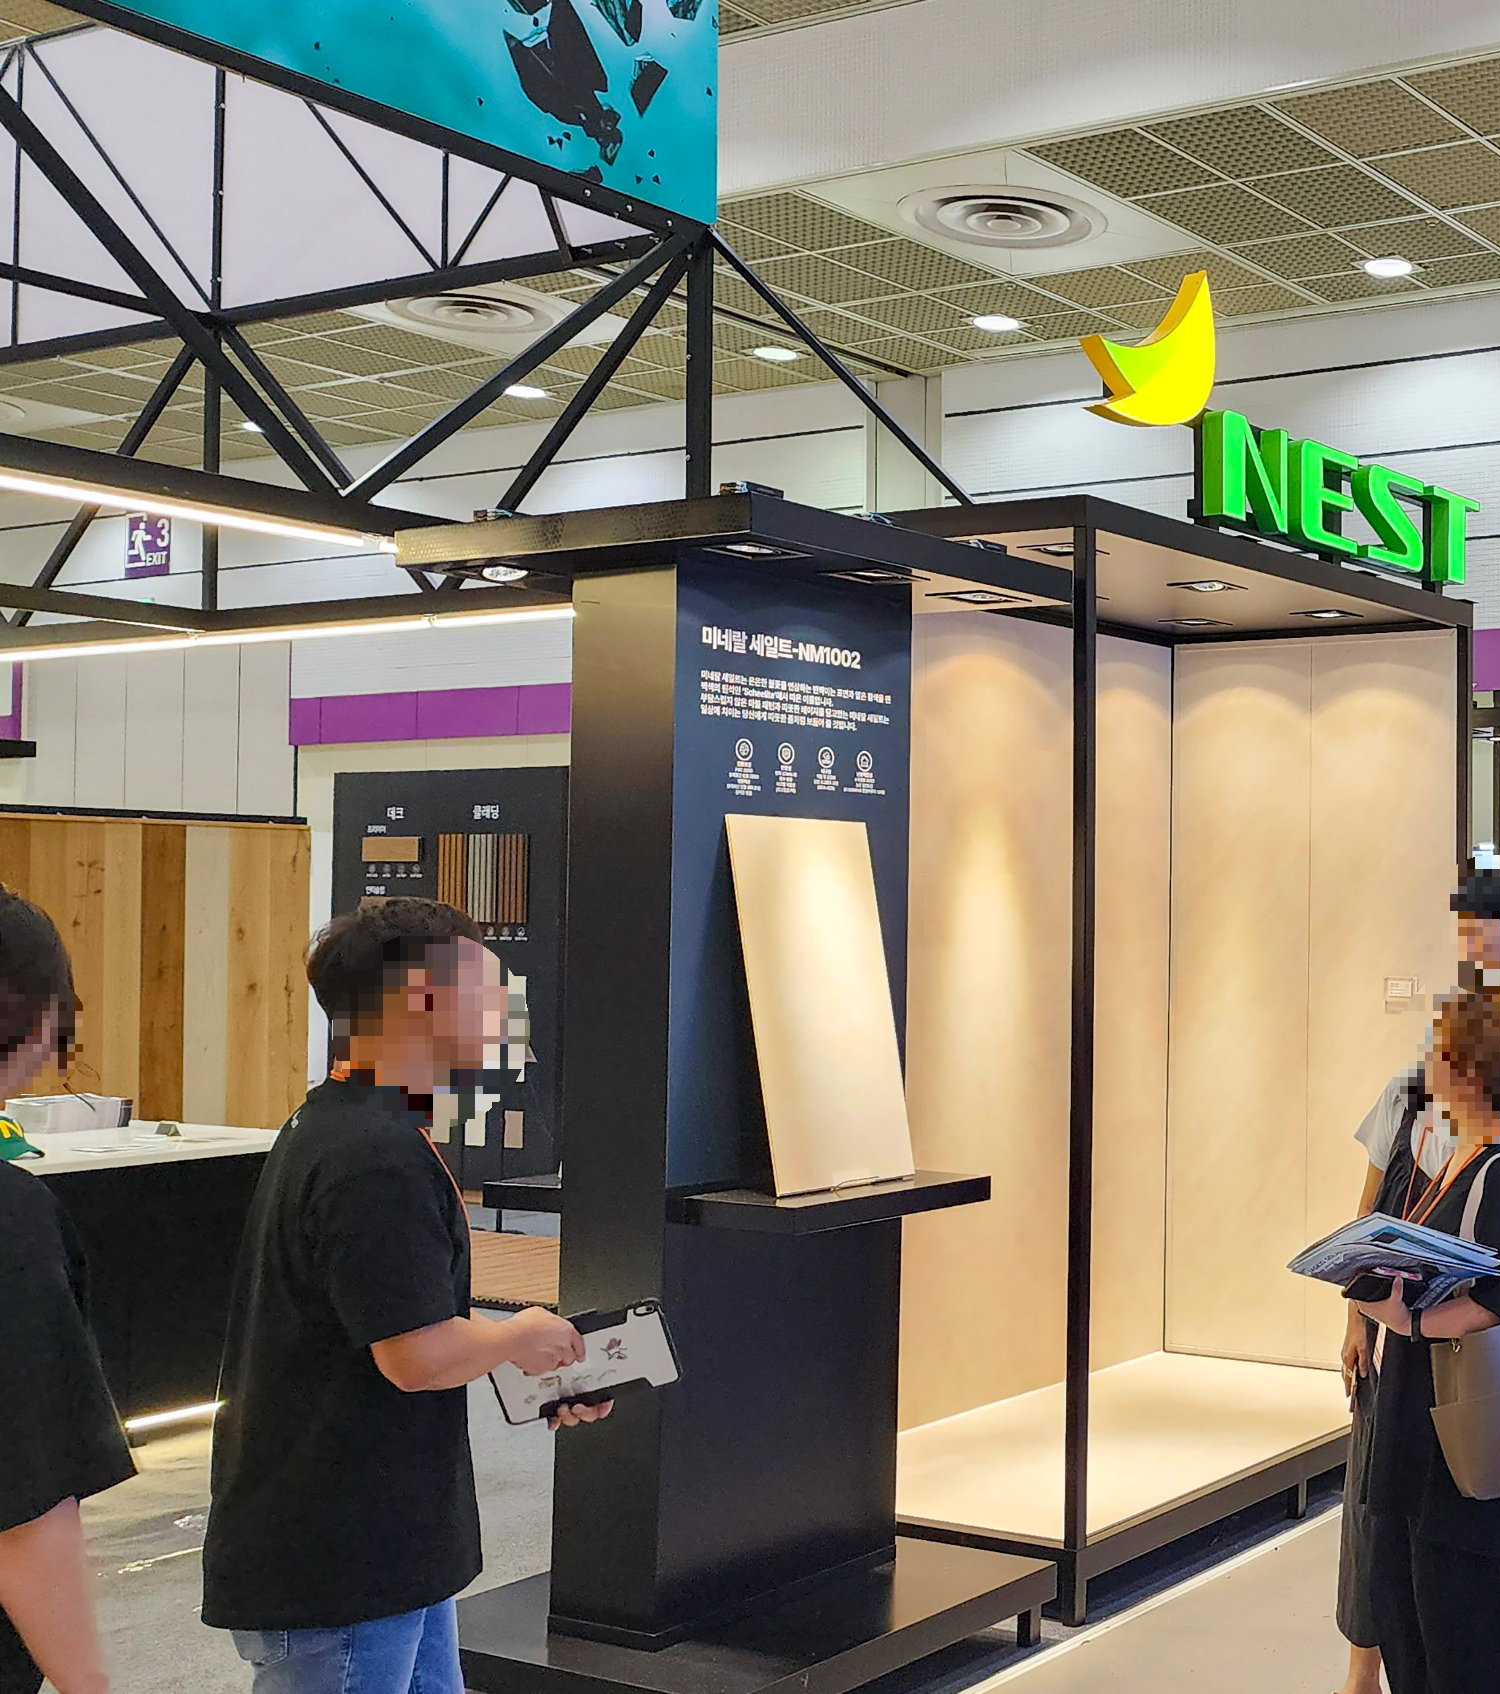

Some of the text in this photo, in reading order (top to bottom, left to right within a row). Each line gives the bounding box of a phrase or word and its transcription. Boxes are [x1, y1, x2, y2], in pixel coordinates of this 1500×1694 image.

[1202, 408, 1481, 585] NEST
[156, 518, 170, 548] 3
[146, 551, 168, 567] EXIT
[701, 625, 862, 669] 미네랄 세일트-NM1002
